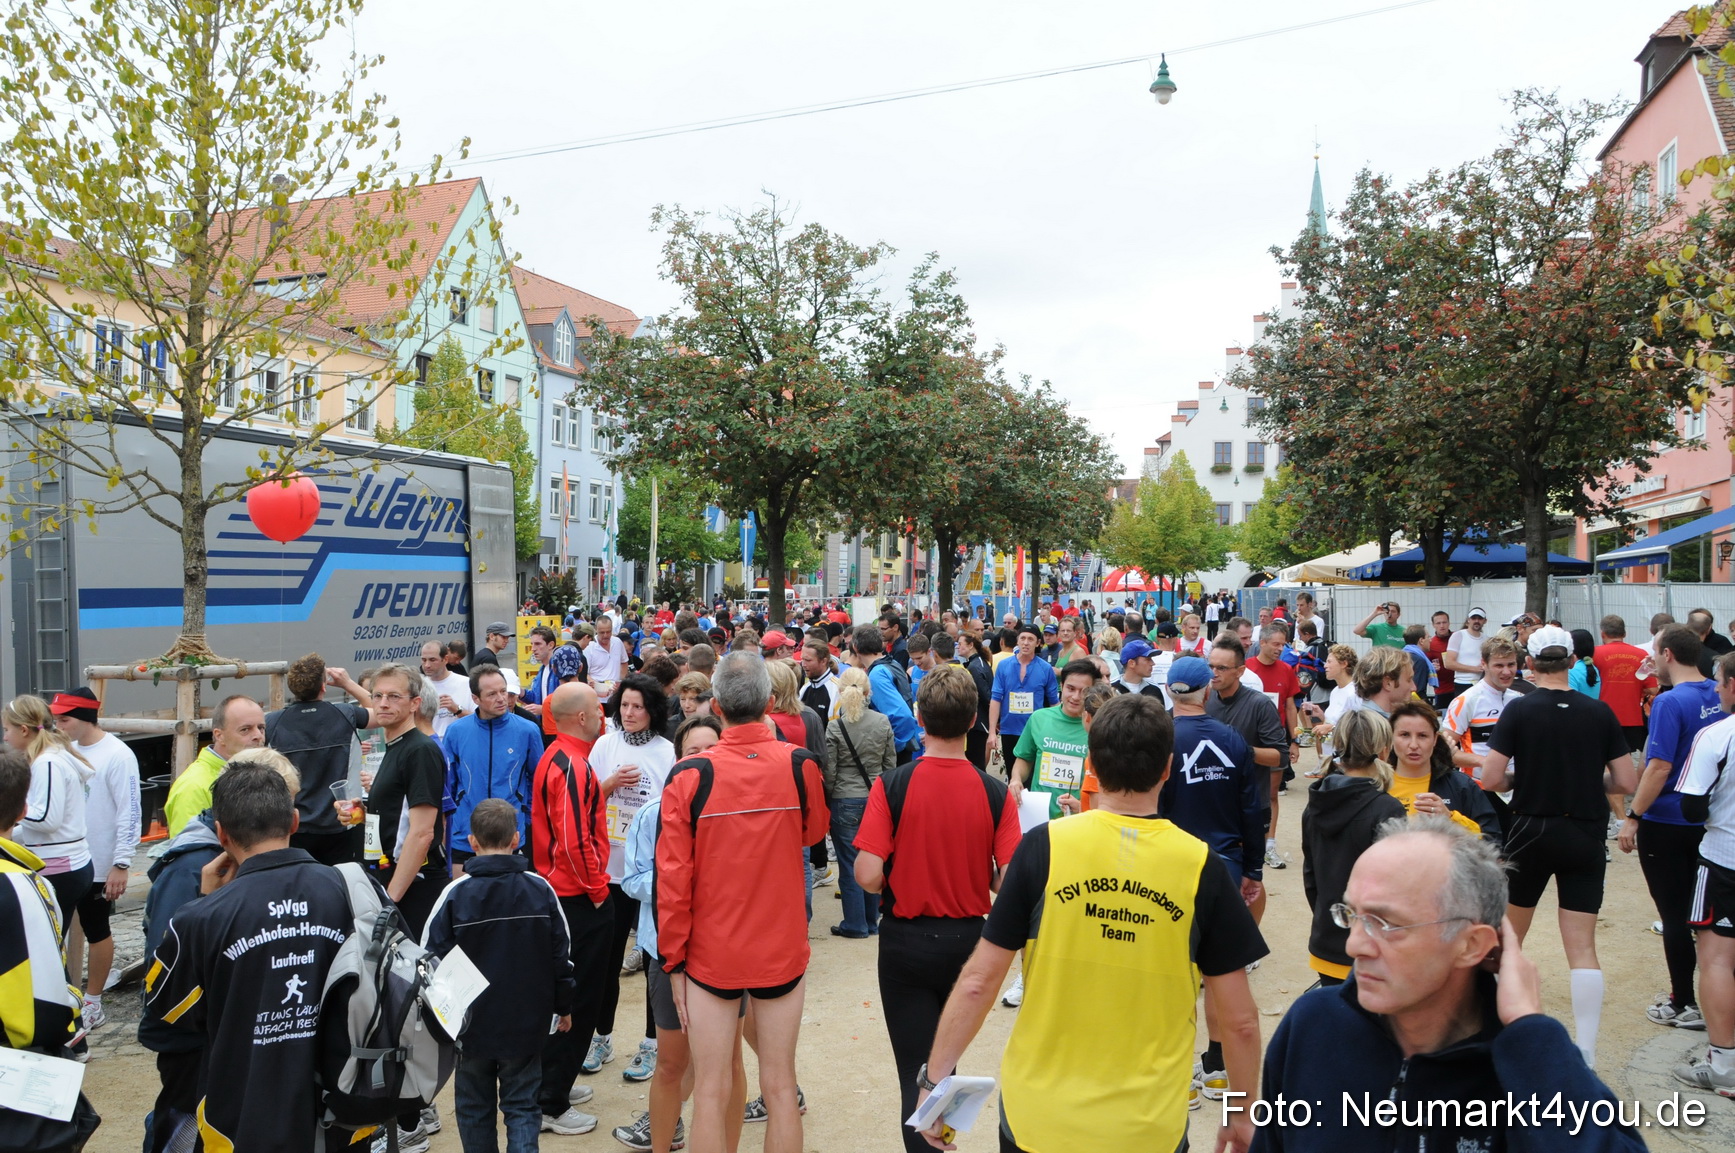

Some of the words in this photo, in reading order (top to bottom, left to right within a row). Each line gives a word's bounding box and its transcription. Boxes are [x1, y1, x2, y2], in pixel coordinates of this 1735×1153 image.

[353, 625, 388, 641] 92361
[390, 624, 433, 640] Berngau
[1042, 736, 1087, 755] Sinupret
[1054, 767, 1074, 779] 218
[618, 809, 634, 820] Tanja
[268, 899, 309, 919] SpVgg
[1054, 882, 1081, 904] TSV
[1083, 878, 1118, 894] 1883
[1121, 879, 1185, 922] Allersberg
[1085, 902, 1155, 926] Marathon-
[1100, 923, 1136, 942] Team
[271, 949, 316, 969] Lauftreff
[271, 1007, 293, 1021] UNS
